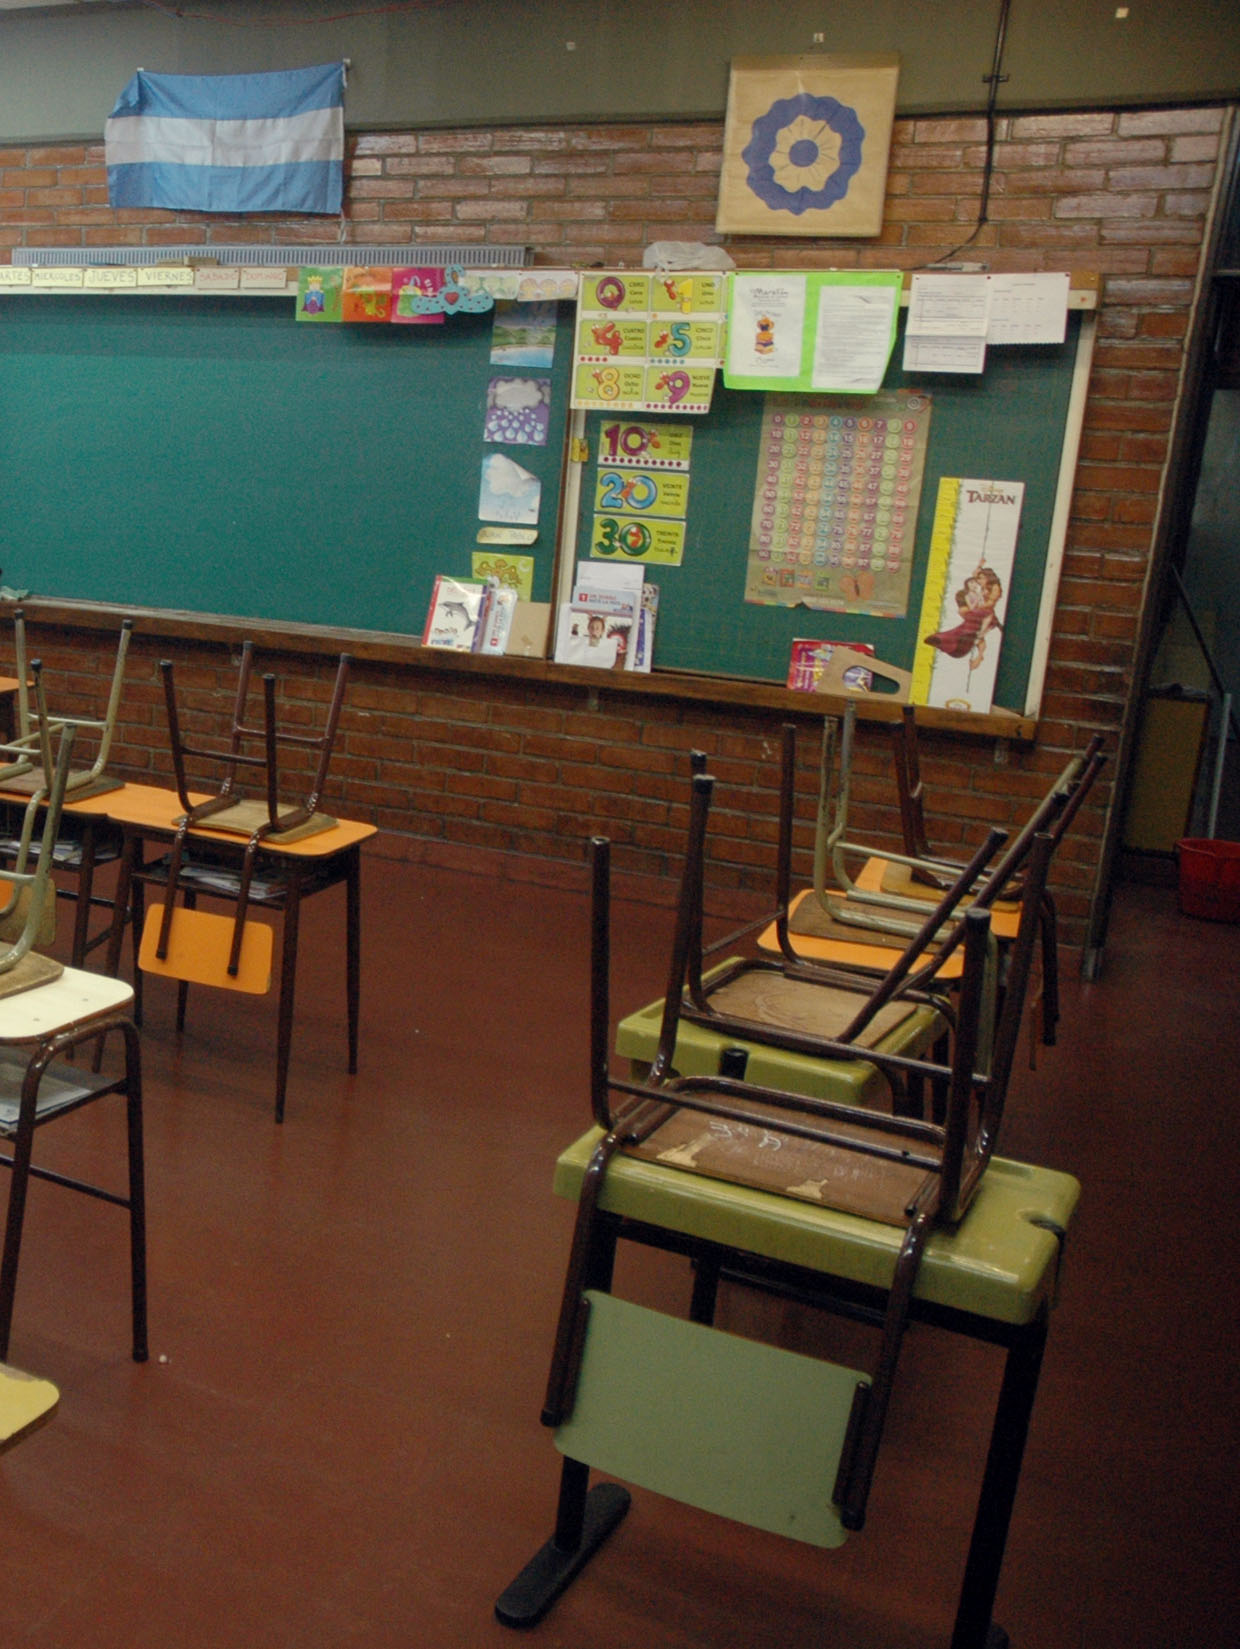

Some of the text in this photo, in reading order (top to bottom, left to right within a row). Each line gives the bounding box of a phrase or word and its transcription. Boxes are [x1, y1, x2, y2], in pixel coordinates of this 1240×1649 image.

[87, 269, 135, 283] JUEVES
[145, 271, 191, 281] VIERNES
[592, 321, 623, 355] 4
[669, 322, 691, 357] 5
[598, 368, 619, 400] 8
[668, 371, 690, 404] 9
[605, 424, 648, 456] 10
[601, 472, 657, 510] 20
[966, 490, 1015, 505] TARZAN
[596, 518, 651, 556] 30
